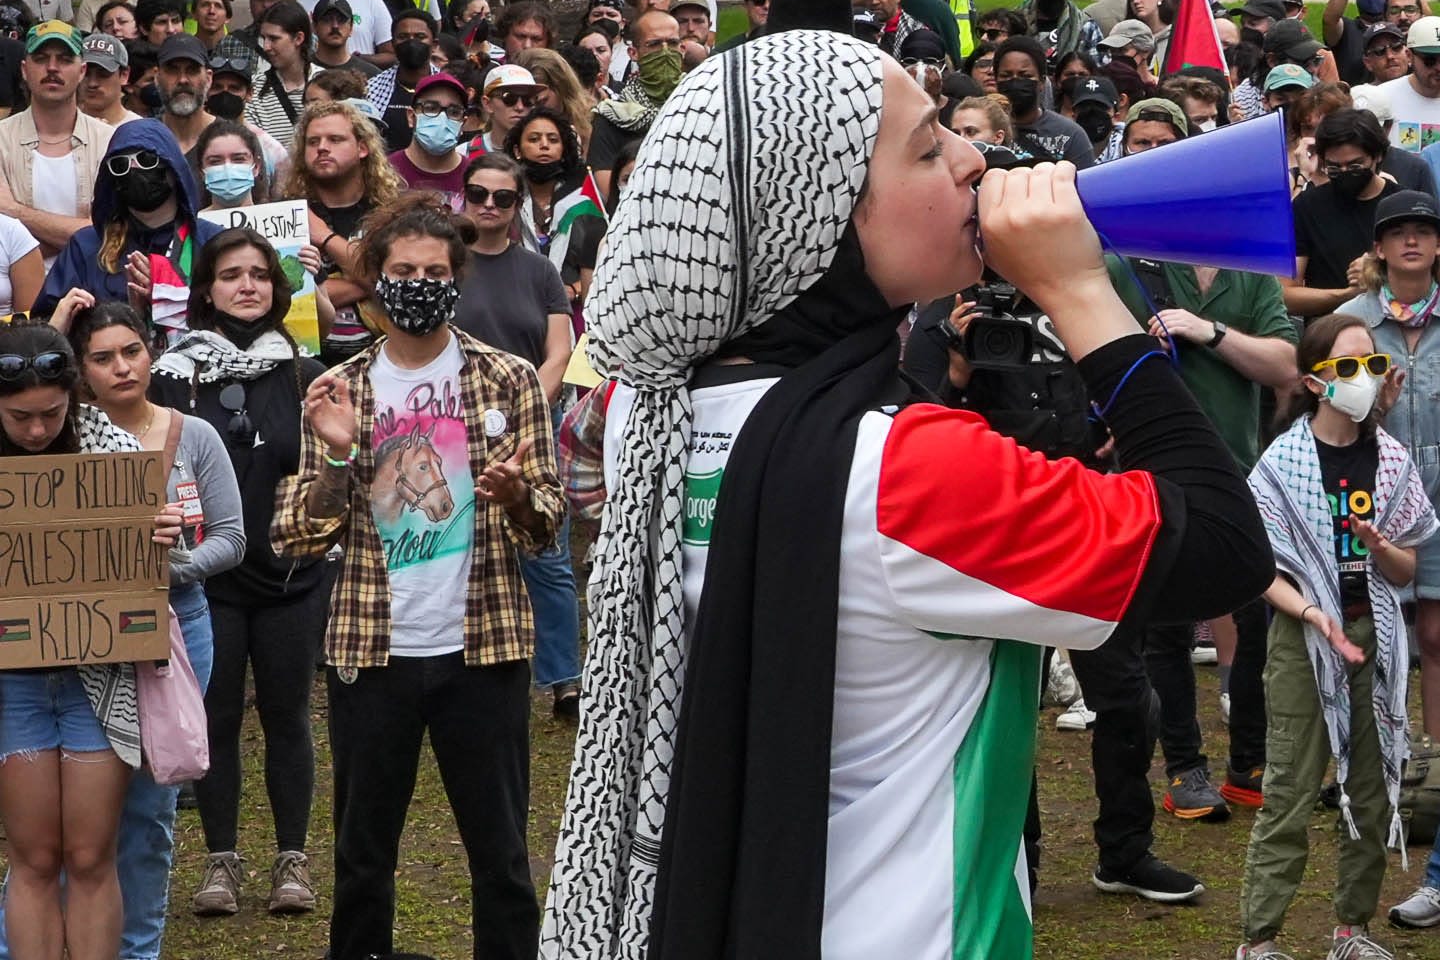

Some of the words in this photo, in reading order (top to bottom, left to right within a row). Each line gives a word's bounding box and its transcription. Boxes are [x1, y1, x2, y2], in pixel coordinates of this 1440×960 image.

[230, 208, 307, 239] PALESTINE
[0, 468, 65, 509] STOP
[75, 458, 159, 510] KILLING
[176, 484, 199, 500] PRESS
[0, 527, 163, 588] PALESTINIAN
[38, 600, 114, 661] KIDS
